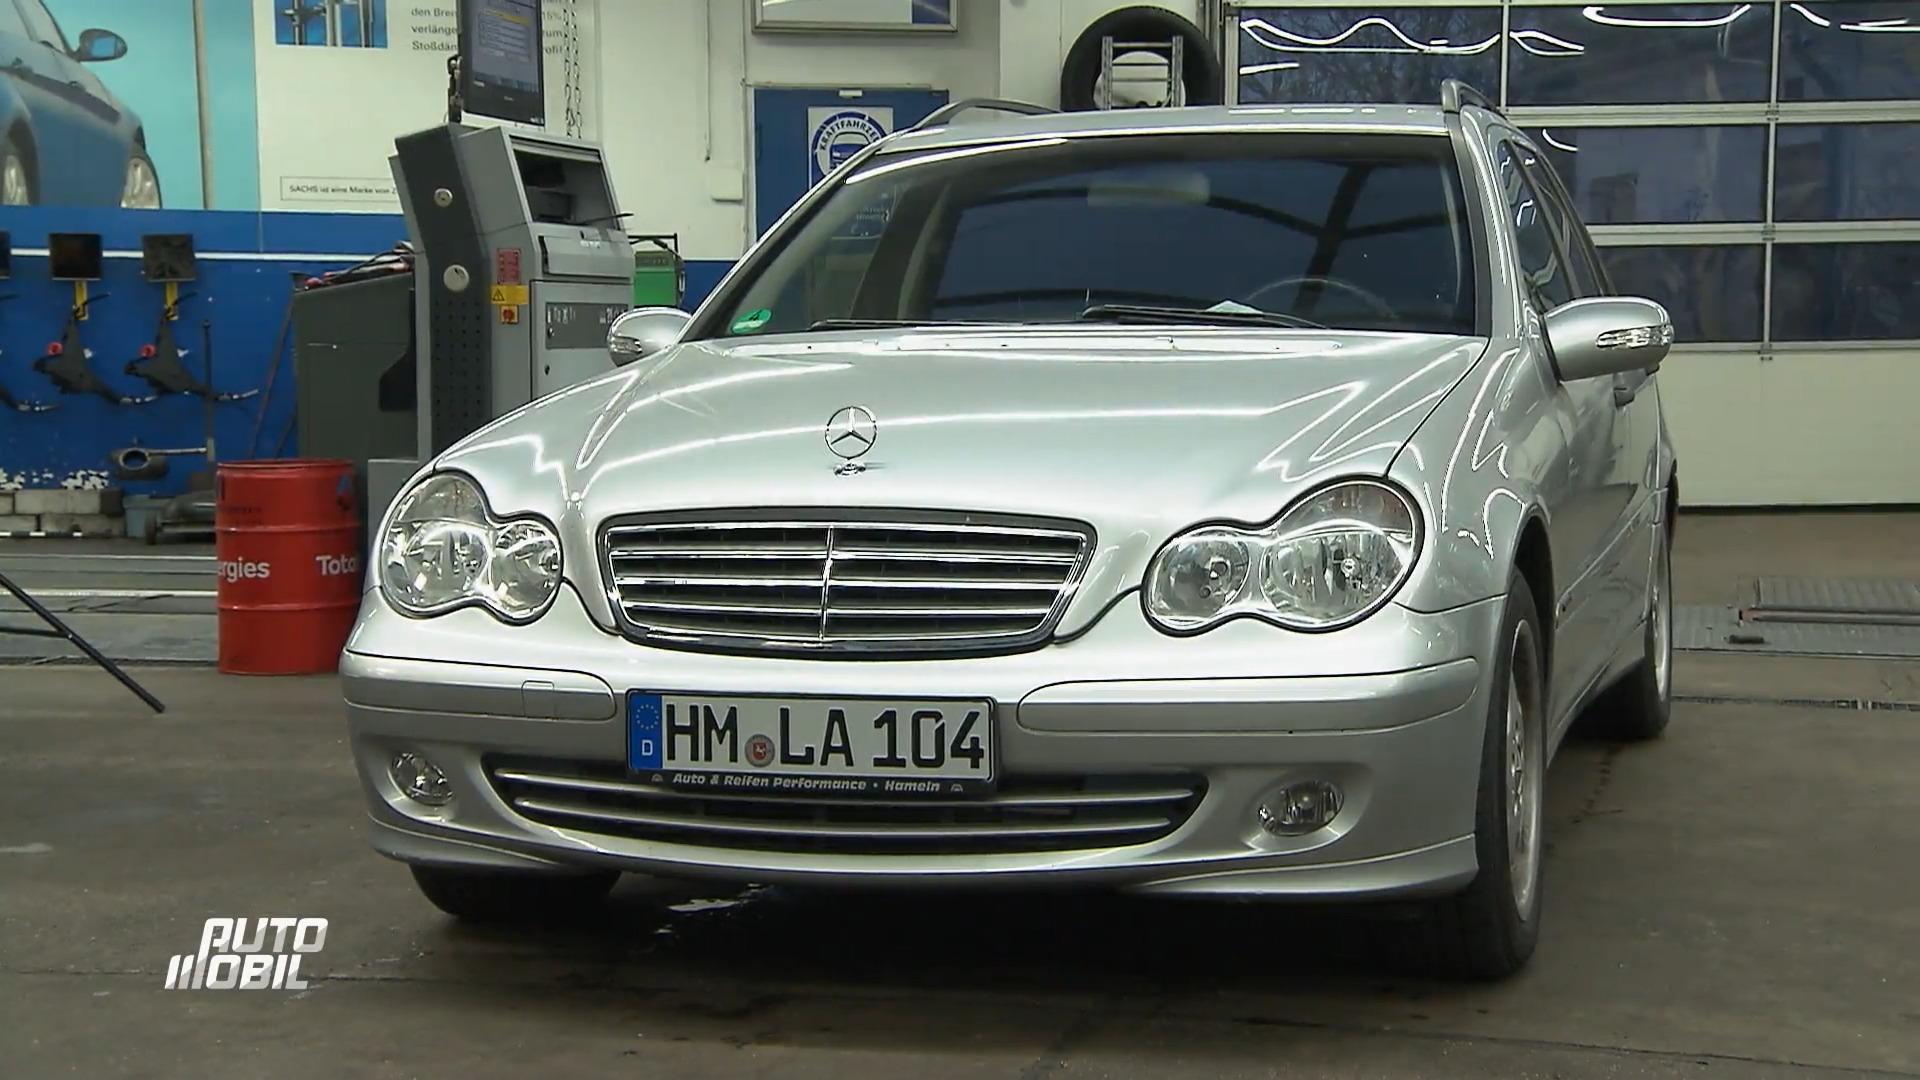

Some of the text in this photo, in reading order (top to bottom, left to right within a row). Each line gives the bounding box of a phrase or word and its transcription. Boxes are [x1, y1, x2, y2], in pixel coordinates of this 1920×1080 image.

[411, 7, 431, 17] den
[289, 185, 318, 193] SACHS
[350, 186, 373, 194] Marke
[666, 703, 985, 770] HM LA 104
[642, 739, 653, 756] D
[672, 773, 706, 785] Auto
[724, 774, 769, 787] Reifen
[773, 776, 867, 791] Performance
